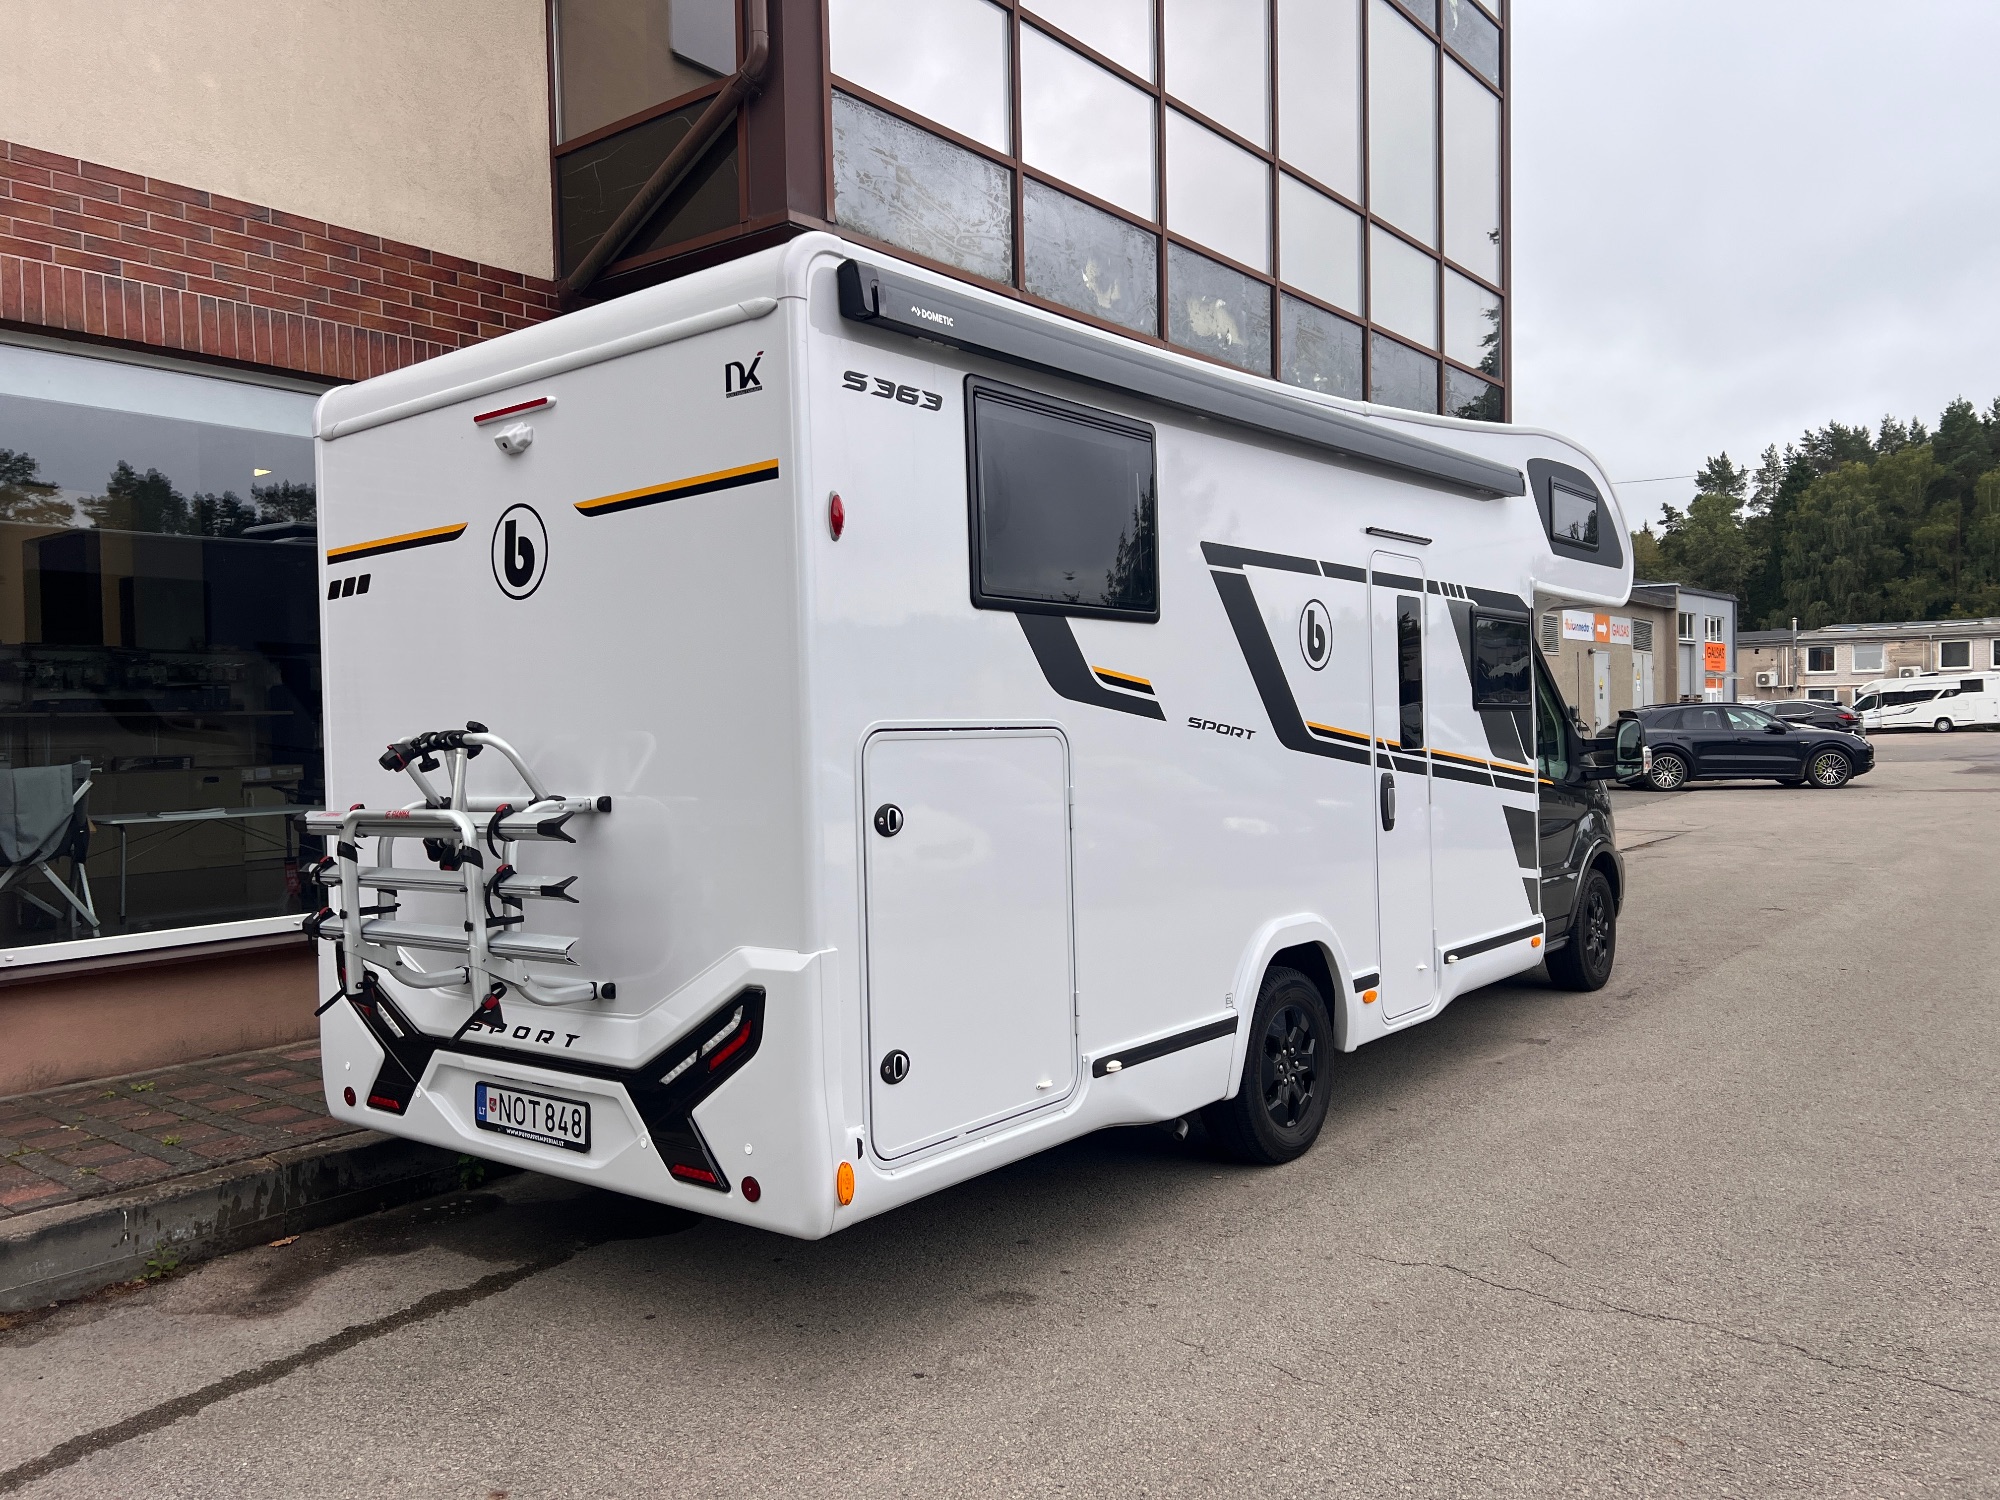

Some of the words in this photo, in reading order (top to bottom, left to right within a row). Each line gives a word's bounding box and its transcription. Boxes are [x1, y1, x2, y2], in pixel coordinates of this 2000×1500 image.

[921, 308, 954, 327] DOMETIC
[842, 370, 869, 392] S
[870, 377, 943, 411] 363
[1612, 623, 1630, 638] GALSAS
[1707, 646, 1725, 660] GALSAS
[1187, 716, 1257, 740] SPORT
[478, 1106, 486, 1115] LT
[498, 1092, 541, 1129] NOT
[545, 1102, 582, 1139] 848
